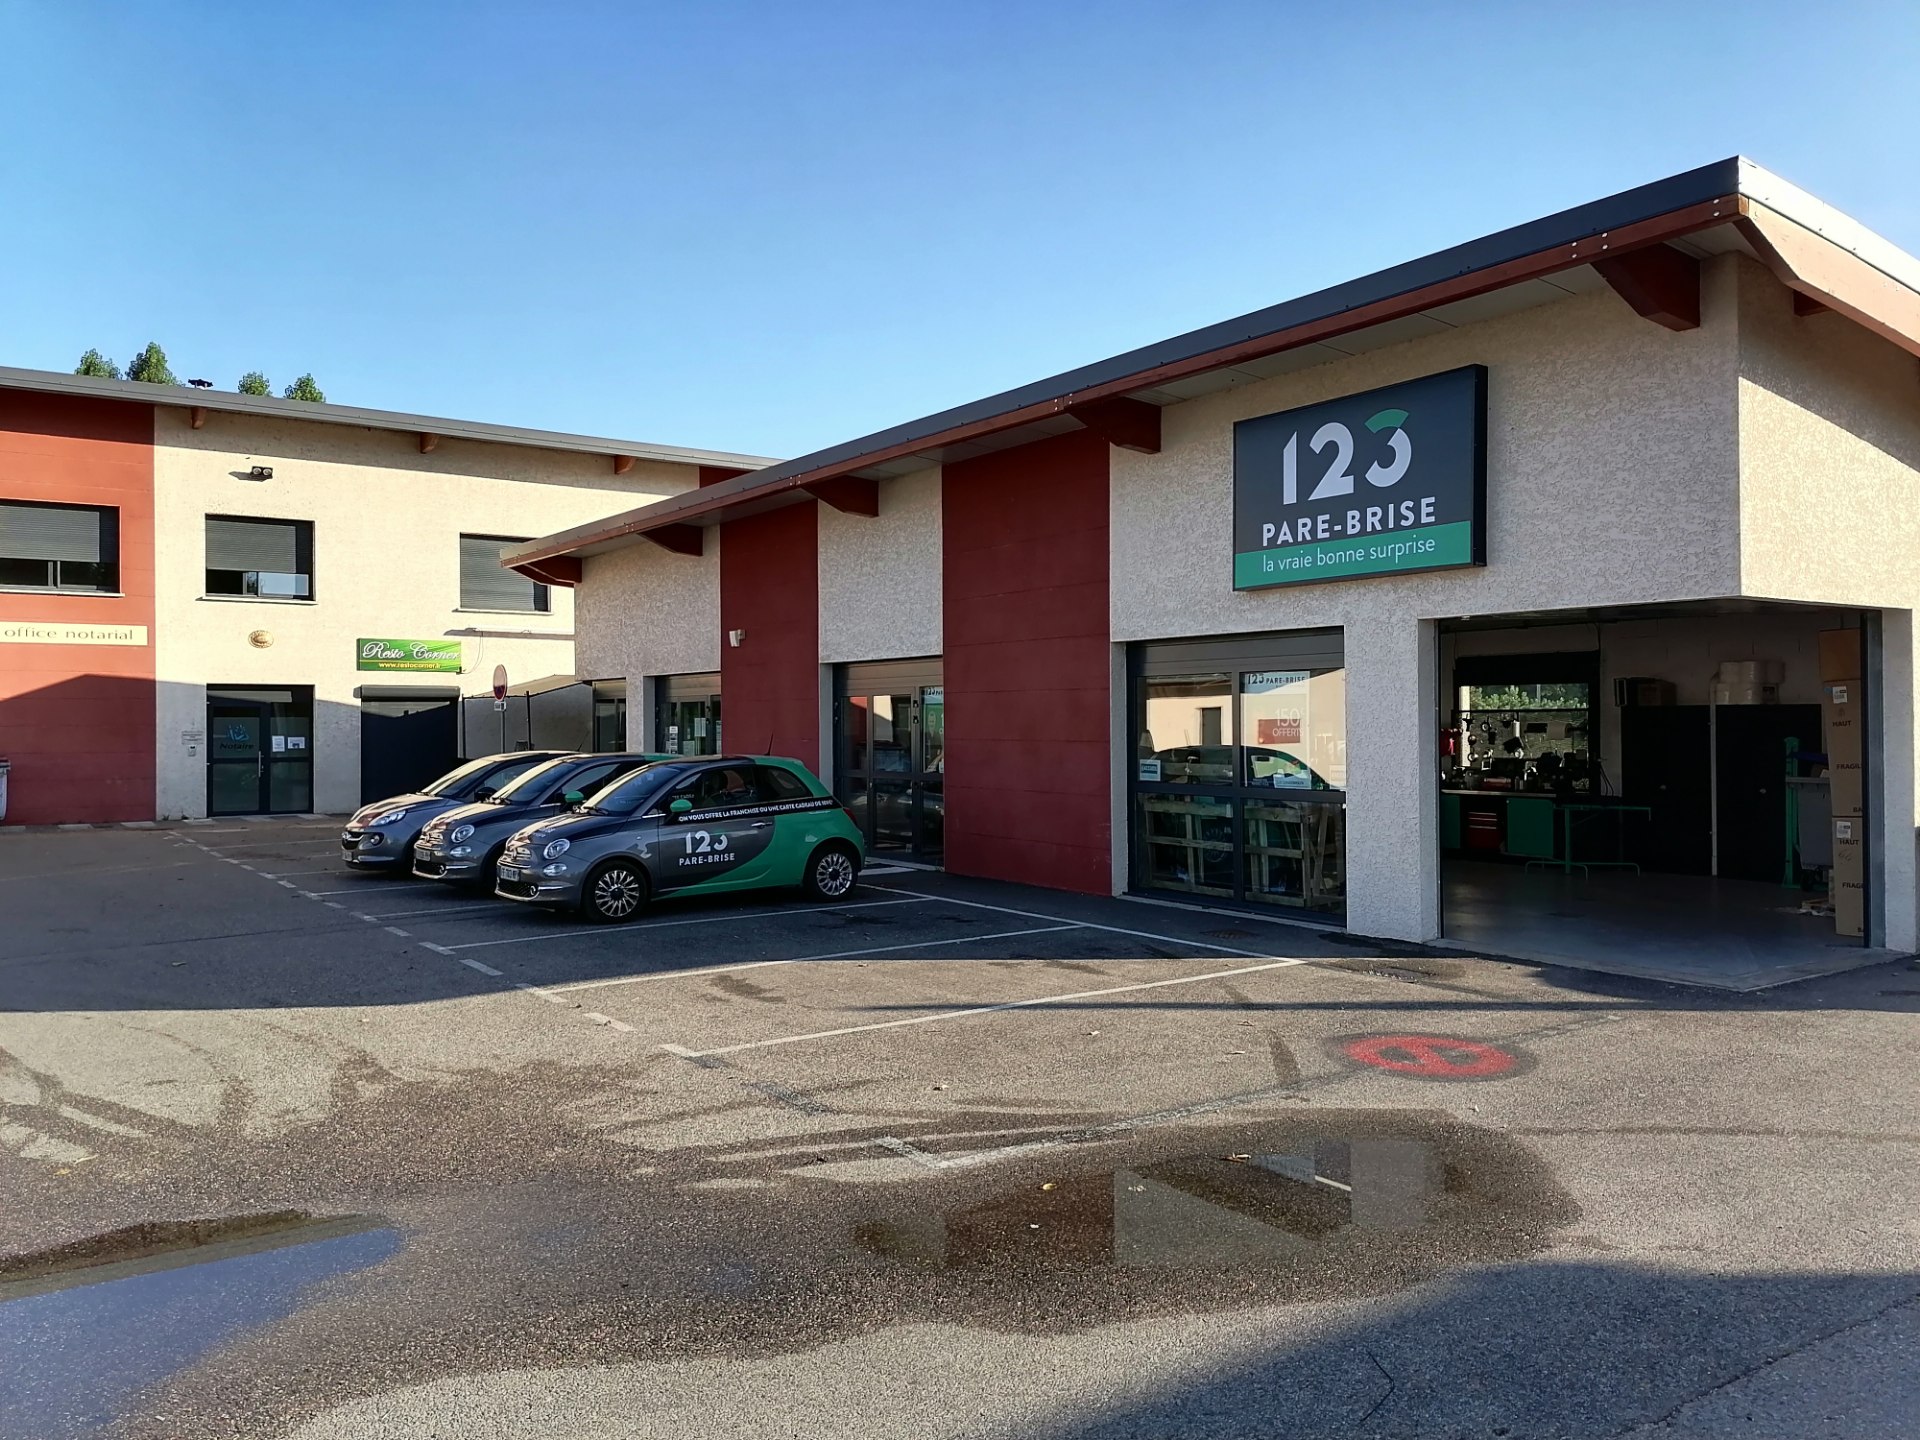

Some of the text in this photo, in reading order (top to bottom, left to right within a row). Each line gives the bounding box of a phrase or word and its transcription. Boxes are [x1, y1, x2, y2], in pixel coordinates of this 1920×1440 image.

[1282, 408, 1412, 505] 123
[1262, 496, 1436, 547] PARE-BRISE
[1262, 534, 1436, 572] la vraie bonne surprise
[4, 626, 133, 641] office notarial
[362, 641, 460, 660] Resto Corner
[220, 742, 255, 750] Notaire
[688, 813, 705, 821] VOUS
[705, 810, 722, 819] OFFRE
[686, 830, 728, 854] 123
[679, 852, 736, 866] PARE-BRISE
